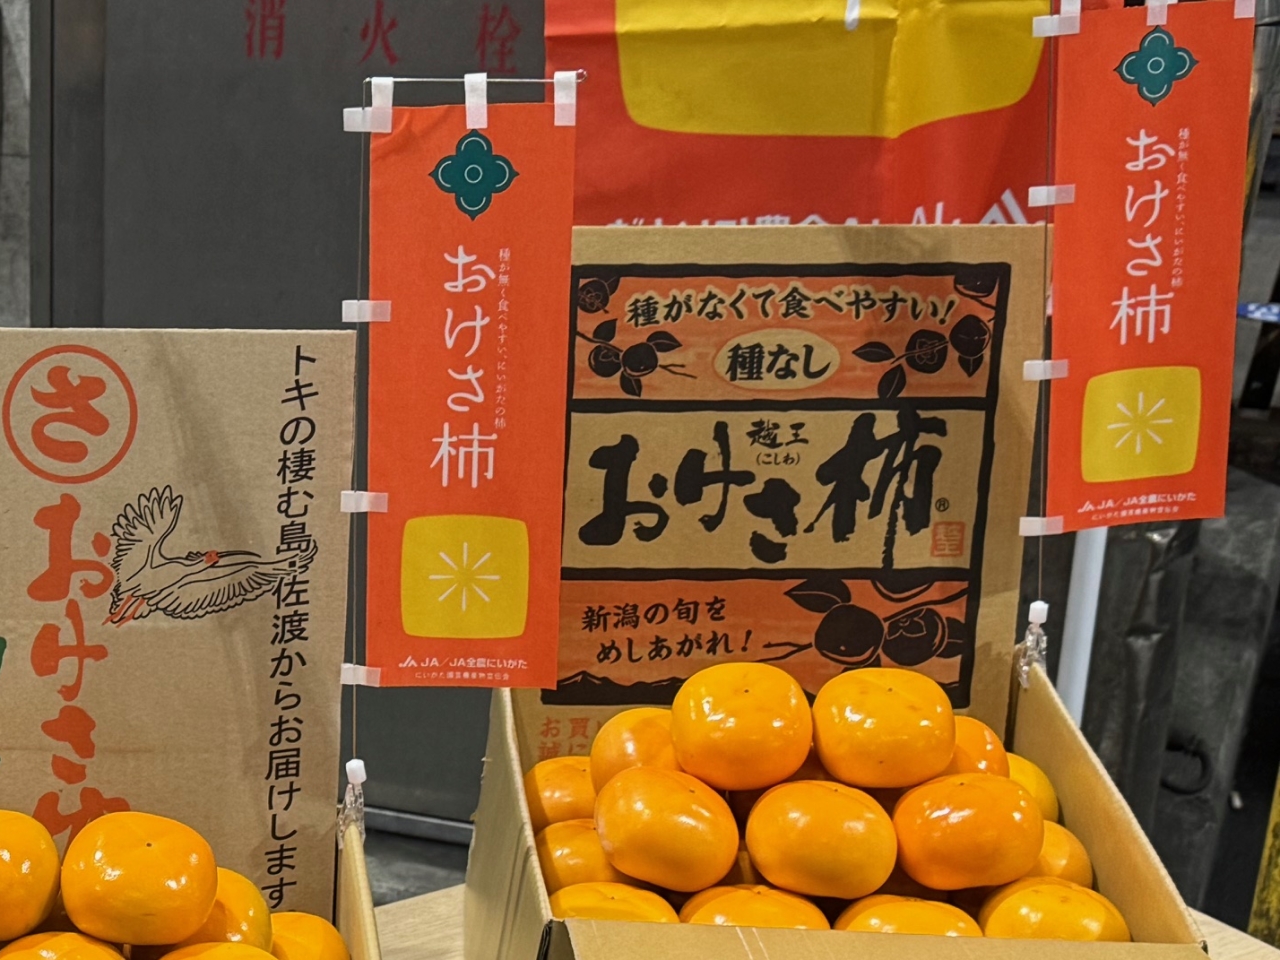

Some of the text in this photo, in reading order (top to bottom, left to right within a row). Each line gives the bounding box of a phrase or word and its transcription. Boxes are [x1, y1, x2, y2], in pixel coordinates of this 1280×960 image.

[244, 0, 521, 74] 消火栓
[1109, 128, 1175, 347] おけさ柿
[429, 245, 499, 489] おけさ柿
[725, 343, 833, 382] 種なし
[746, 418, 809, 449] 越王
[578, 407, 948, 570] おけさ柿
[581, 595, 727, 635] 新潟の旬を
[540, 716, 602, 739] お買
